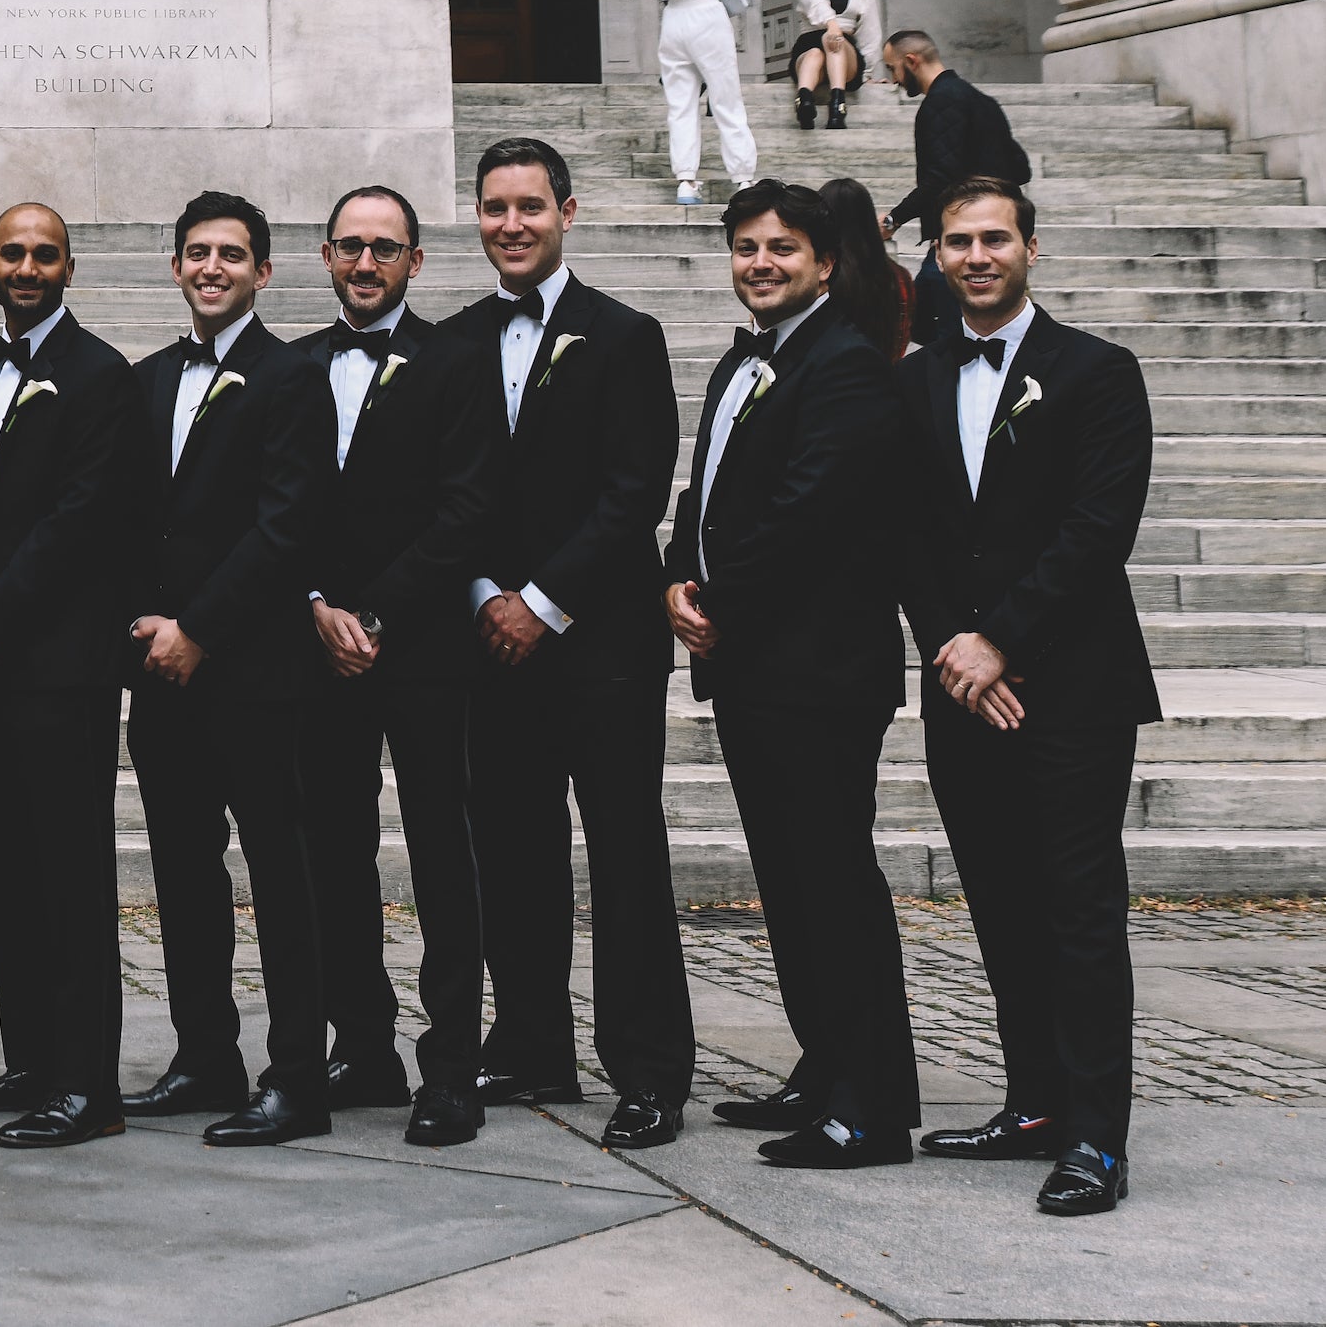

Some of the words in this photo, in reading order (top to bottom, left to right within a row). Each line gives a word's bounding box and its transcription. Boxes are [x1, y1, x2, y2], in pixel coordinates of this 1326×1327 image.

[6, 8, 41, 18] NEW
[47, 8, 87, 19] YORK
[94, 8, 148, 19] PUBLIC
[154, 9, 218, 19] LIBRARY
[75, 44, 257, 60] SCHWARZMAN
[35, 78, 154, 94] BUILDING
